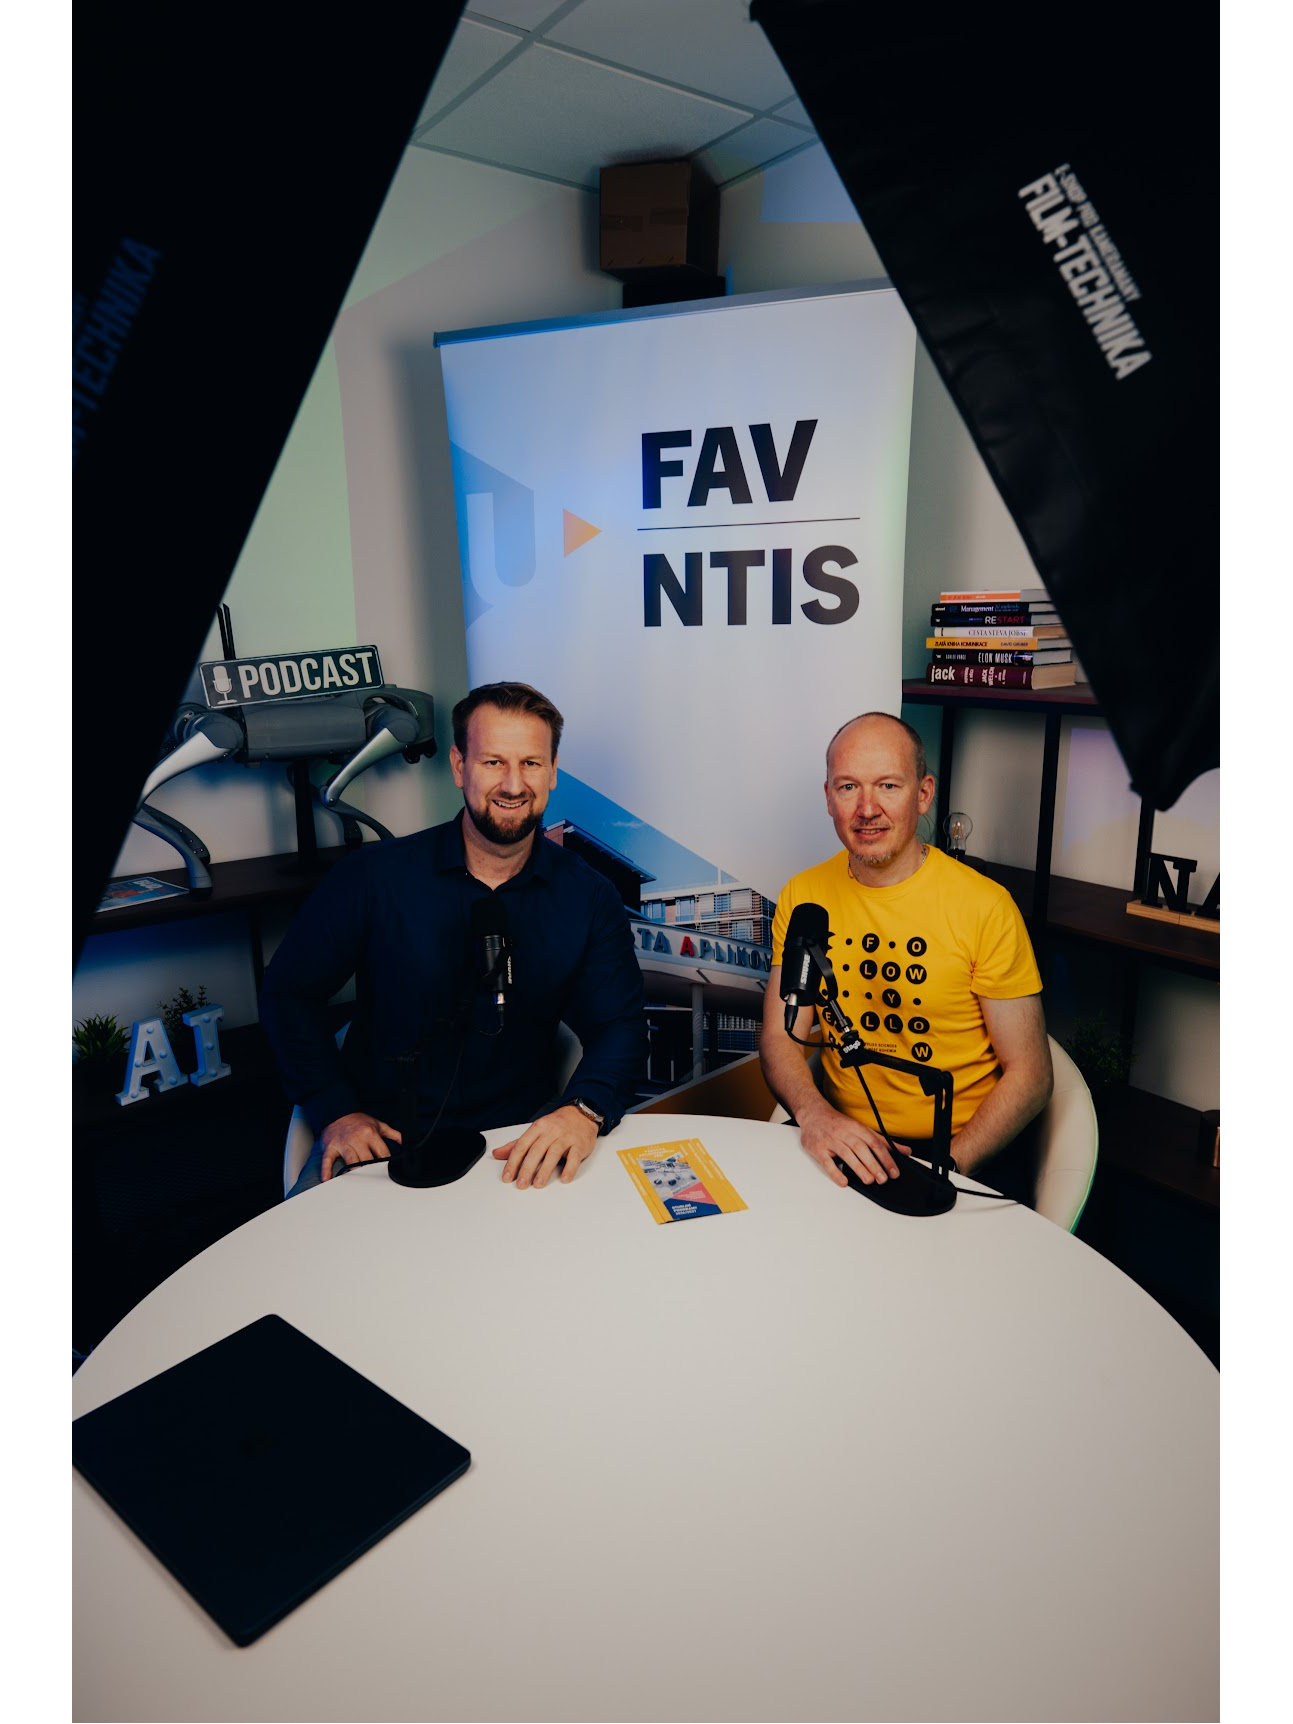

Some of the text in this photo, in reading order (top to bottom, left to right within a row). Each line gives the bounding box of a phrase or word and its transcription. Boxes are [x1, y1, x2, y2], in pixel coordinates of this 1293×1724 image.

[1018, 172, 1153, 381] FILM-TECHNIKA
[641, 418, 819, 510] FAV
[643, 544, 860, 628] NTIS
[961, 605, 995, 613] Management
[985, 616, 1026, 625] RESTART
[237, 652, 373, 699] PODCAST
[930, 665, 956, 683] jack
[978, 652, 993, 664] ELON
[994, 652, 1013, 664] MUSK
[115, 1003, 232, 1106] AI
